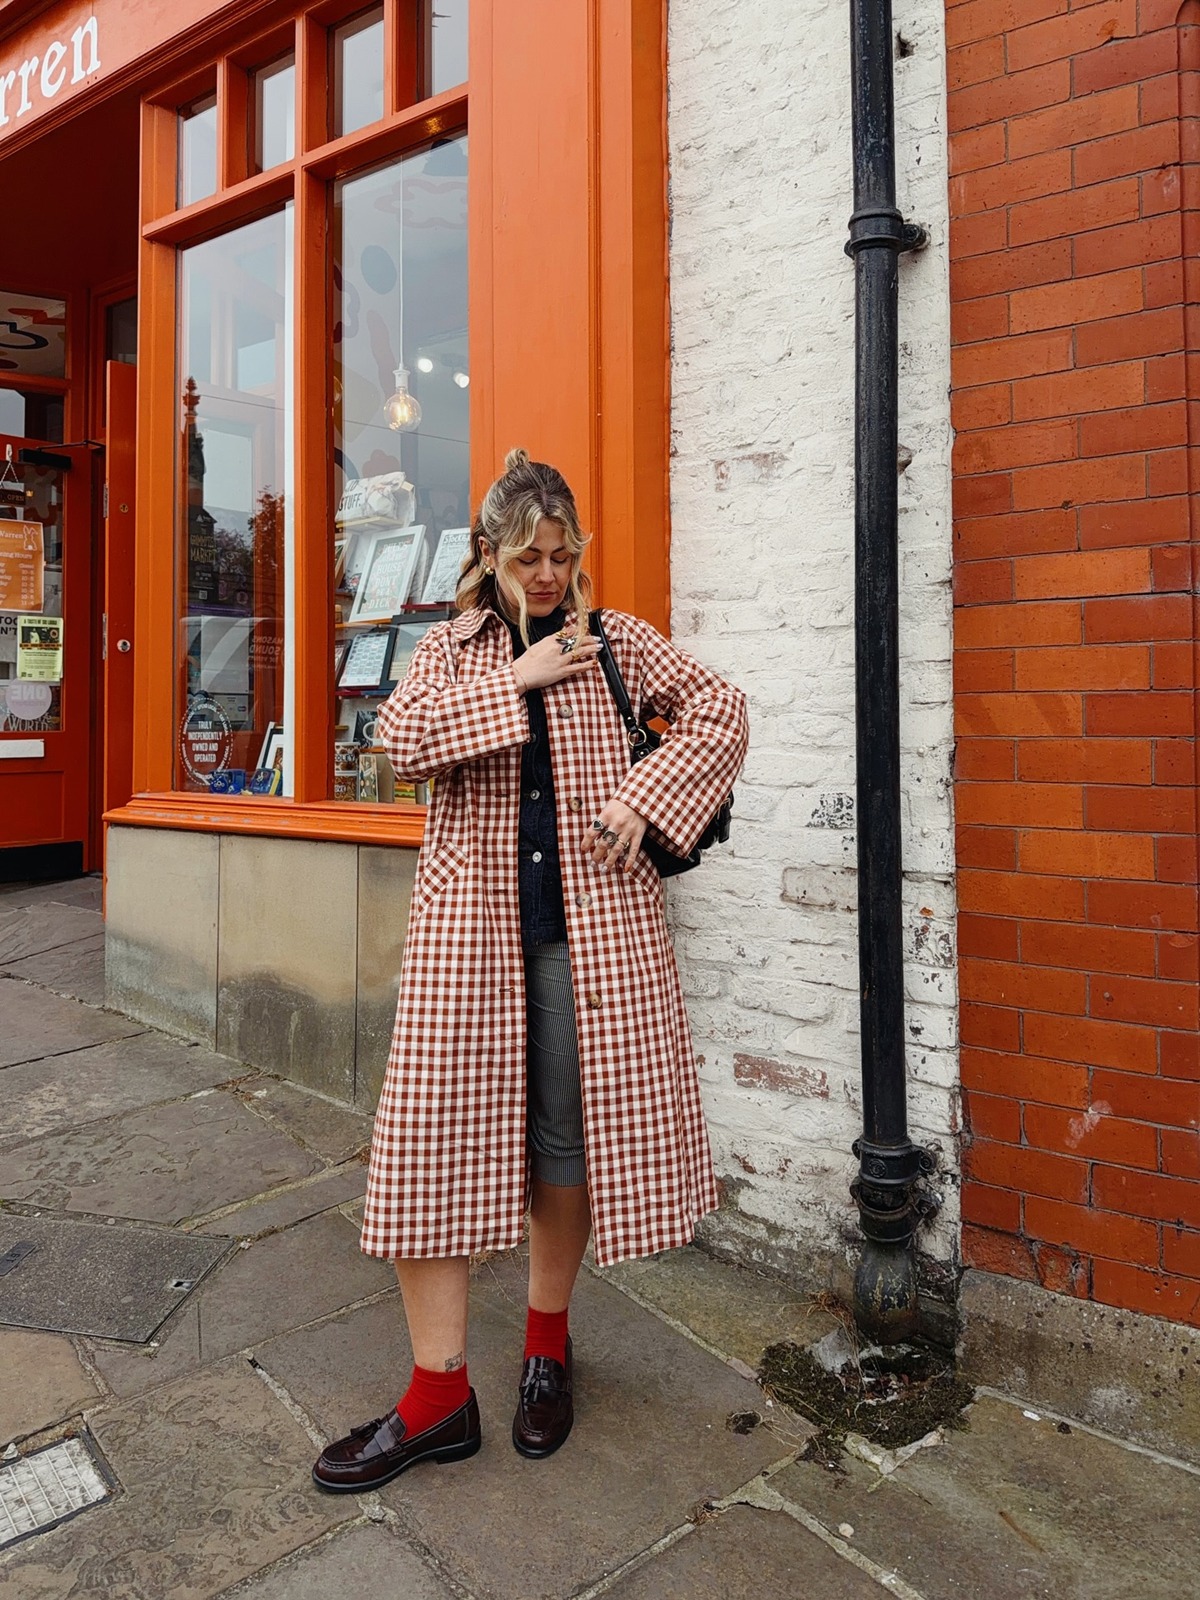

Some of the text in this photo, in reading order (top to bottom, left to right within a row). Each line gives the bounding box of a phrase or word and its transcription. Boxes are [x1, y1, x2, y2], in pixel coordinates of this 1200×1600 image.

[198, 721, 212, 729] TRULY
[188, 732, 222, 740] INDEPENDENTLY
[192, 743, 208, 751] OWNED
[209, 743, 218, 751] AND
[194, 754, 216, 763] OPERATED
